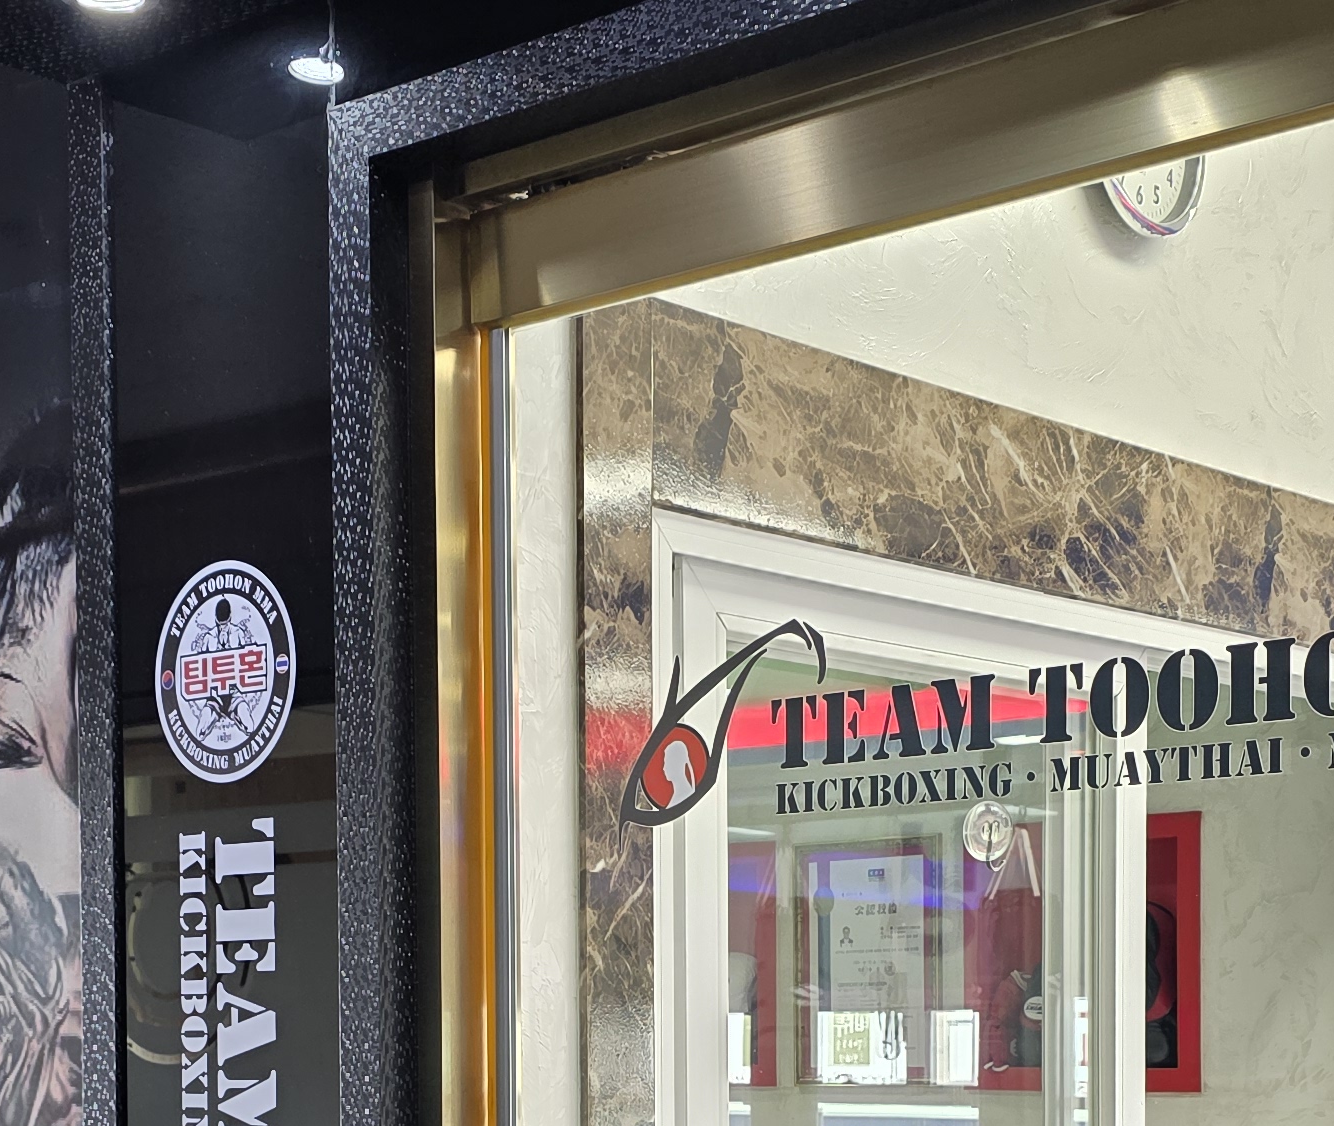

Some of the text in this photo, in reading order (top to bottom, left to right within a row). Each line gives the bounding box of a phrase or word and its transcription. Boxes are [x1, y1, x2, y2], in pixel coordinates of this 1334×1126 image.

[1136, 184, 1160, 205] 6 5
[1166, 168, 1173, 188] 4
[170, 573, 278, 639] TEAM TOOHON MMA
[183, 649, 264, 696] 팀투혼
[167, 695, 284, 769] KICKBOXING MUAYTHAI
[771, 674, 996, 770] TEAM
[775, 761, 1013, 815] KICKBOXING
[1050, 737, 1283, 792] MUAYTHAI
